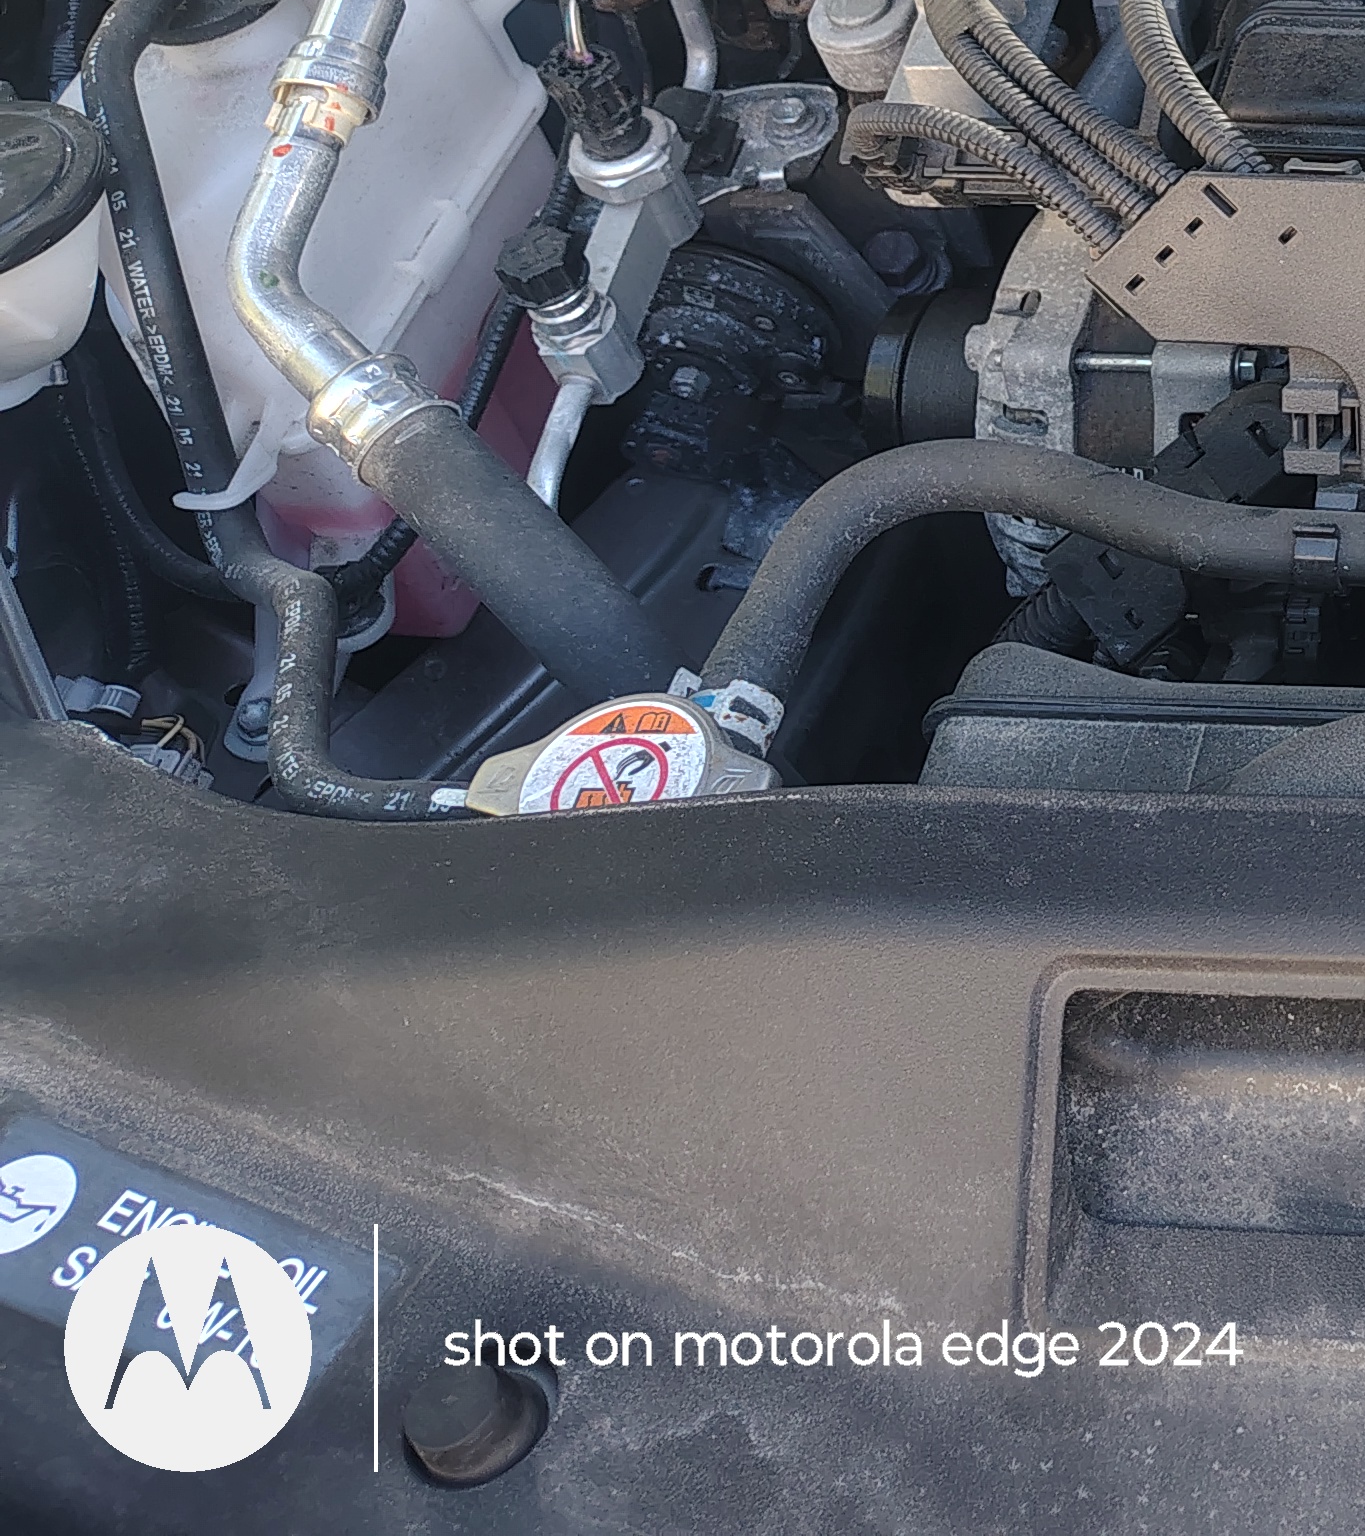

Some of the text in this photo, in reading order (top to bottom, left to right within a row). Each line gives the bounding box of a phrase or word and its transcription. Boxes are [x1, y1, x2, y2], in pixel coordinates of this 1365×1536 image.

[110, 190, 128, 212] 05
[117, 228, 137, 250] 21
[126, 260, 156, 320] WATER
[144, 323, 175, 388] >EPDM<
[184, 458, 203, 480] 21
